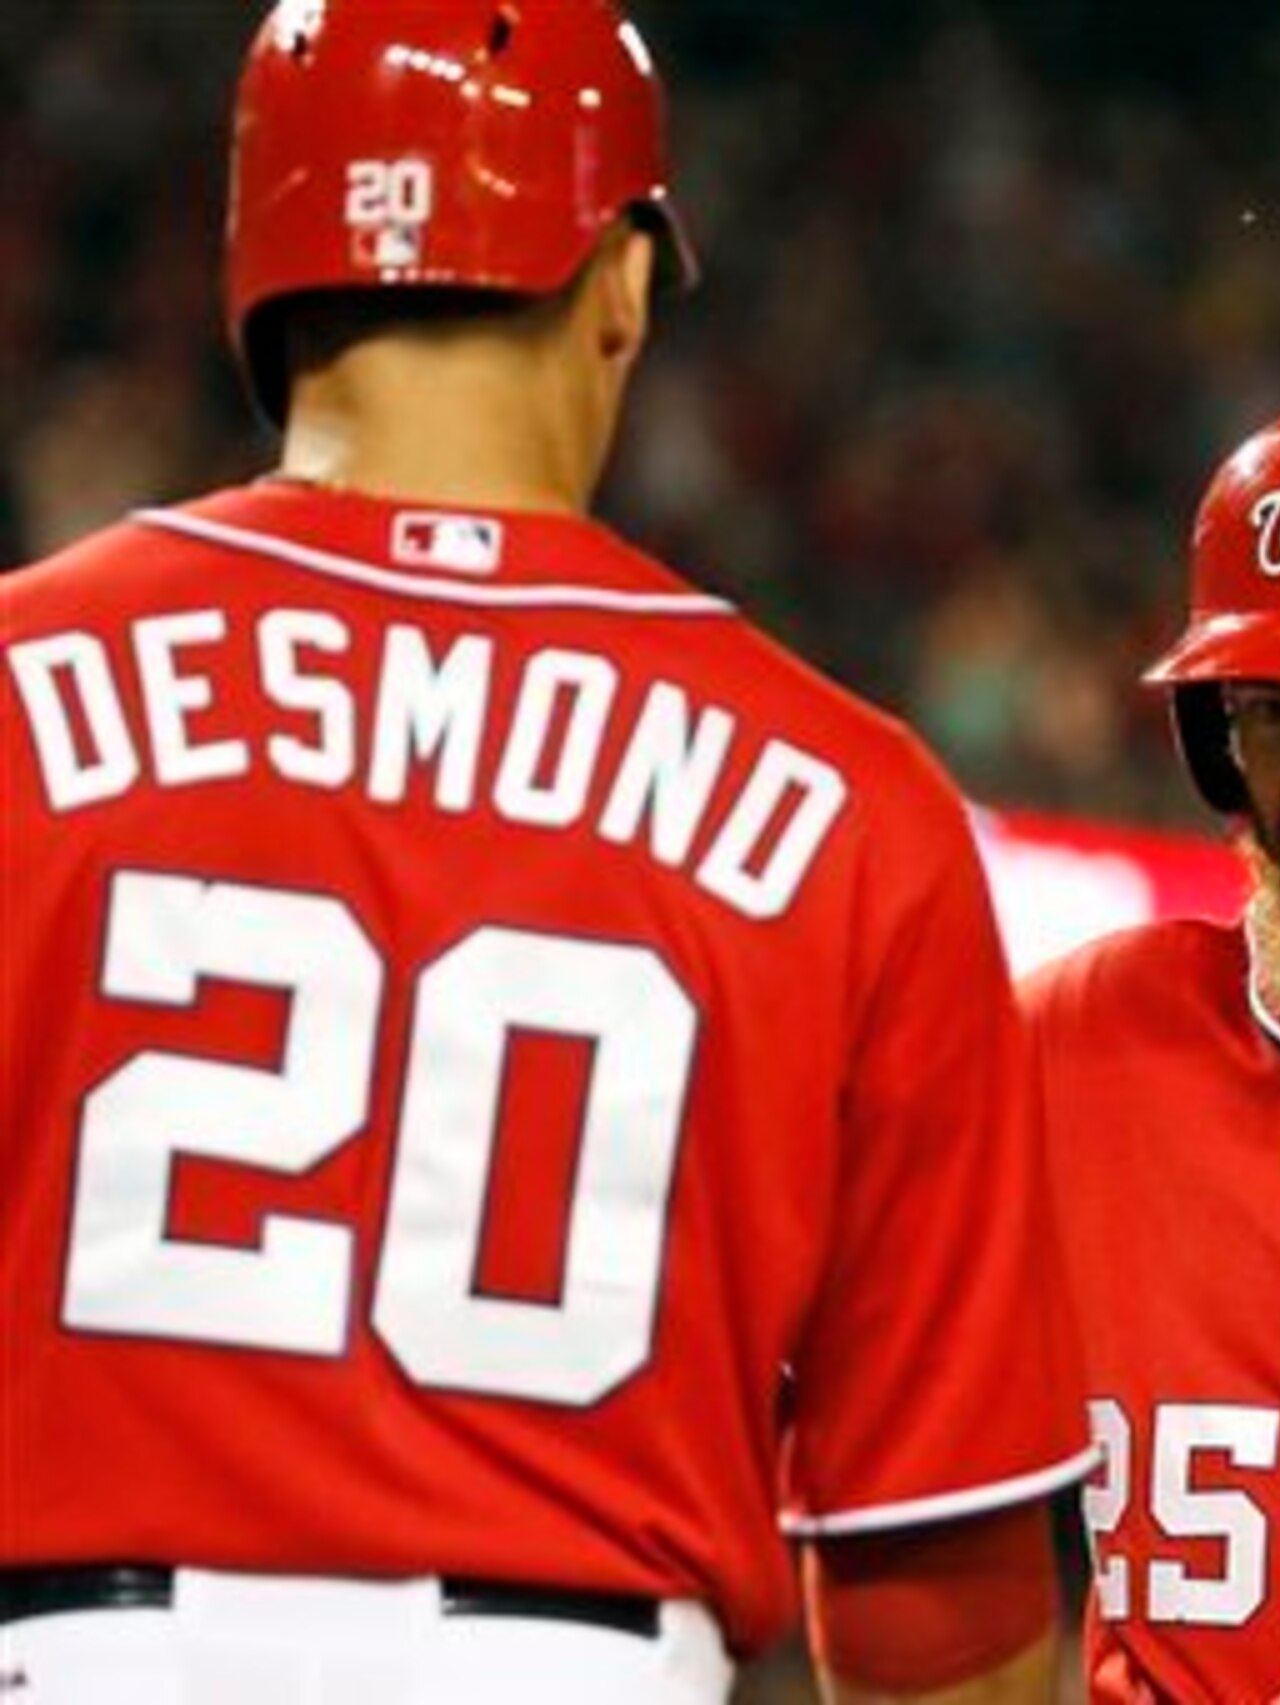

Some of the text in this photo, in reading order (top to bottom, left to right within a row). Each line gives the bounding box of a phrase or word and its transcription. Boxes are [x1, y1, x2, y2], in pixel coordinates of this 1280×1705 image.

[345, 159, 433, 223] 20
[7, 608, 847, 919] DESMOND
[60, 869, 700, 1407] 20
